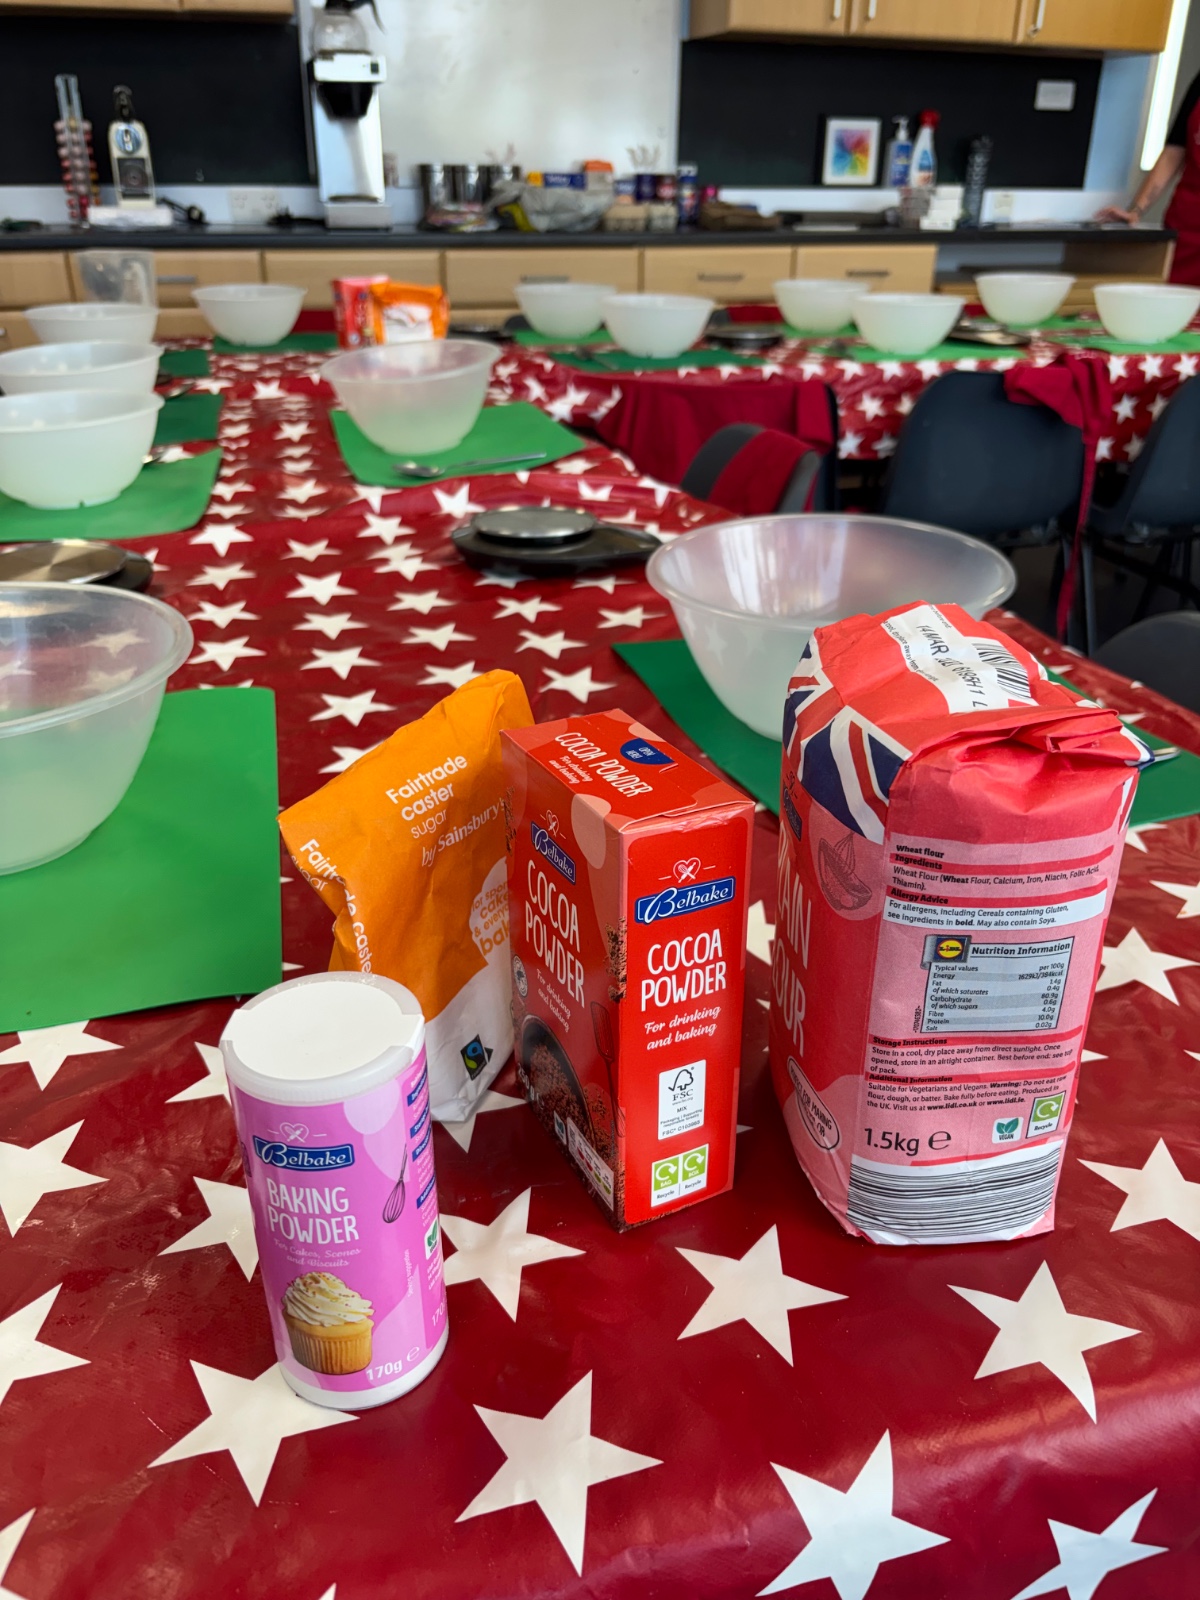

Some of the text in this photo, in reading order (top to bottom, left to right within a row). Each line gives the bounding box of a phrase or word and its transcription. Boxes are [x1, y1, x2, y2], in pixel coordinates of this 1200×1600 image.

[548, 758, 581, 785] and baking
[555, 732, 654, 798] COCOA POWDER
[568, 761, 594, 782] drinking
[385, 755, 468, 805] Fairtrade
[401, 783, 454, 821] caster
[410, 809, 447, 840] sugar
[421, 846, 437, 868] by
[534, 829, 573, 877] Belbake
[895, 854, 942, 870] Ingredients
[896, 844, 944, 858] Wheat flour
[893, 866, 917, 877] Wheat
[919, 871, 939, 881] Flour
[940, 874, 969, 884] (Wheat
[970, 877, 991, 885] Flour,
[993, 877, 1025, 885] Calcium,
[1045, 873, 1068, 882] Niacin,
[527, 859, 580, 953] COCOA
[644, 887, 729, 924] Belbake
[891, 888, 948, 904] Allergy Advice
[888, 911, 900, 919] see
[902, 913, 944, 925] ingredients
[1011, 918, 1037, 926] contain
[1039, 917, 1056, 925] Soya.
[889, 900, 1068, 918] For allergens, including Cereals containing Gluten,
[352, 921, 373, 974] caste
[525, 900, 585, 1008] POWDER
[647, 928, 723, 975] COCOA
[972, 943, 1070, 955] Nutrition Information
[641, 961, 727, 1012] POWDER
[546, 985, 571, 1019] drinking
[930, 995, 972, 1003] Carbohydrate
[549, 1003, 570, 1033] baking
[644, 1006, 721, 1035] For drinking
[647, 1023, 717, 1050] and baking
[873, 1037, 947, 1047] Storage Instructions
[871, 1057, 899, 1066] opened,
[938, 1056, 961, 1065] airtight
[872, 1047, 890, 1056] Store
[906, 1049, 922, 1057] cool,
[924, 1049, 935, 1057] dry
[868, 1082, 896, 1092] Suitable
[898, 1084, 907, 1092] for
[909, 1084, 948, 1094] Vegetarians
[964, 1083, 988, 1091] Vegans.
[869, 1074, 908, 1083] Additional
[673, 1089, 693, 1101] FSC
[867, 1091, 885, 1100] flour,
[887, 1095, 911, 1103] dough,
[977, 1090, 997, 1098] before
[1022, 1086, 1052, 1094] Produced
[811, 1101, 832, 1130] MAKING
[893, 1103, 908, 1111] Visit
[927, 1101, 977, 1111] www.lidl.co.uk
[864, 1127, 920, 1157] 1.5kg
[999, 1122, 1053, 1141] VEGAN Recycle
[261, 1142, 346, 1166] Belbake
[656, 1179, 702, 1199] Recycle Recycle
[660, 1170, 699, 1188] BAG BOX
[267, 1177, 349, 1215] BAKING
[268, 1205, 359, 1245] POWDER
[286, 1254, 349, 1267] and Biscuits
[289, 1246, 361, 1258] Cakes, Scones
[366, 1359, 403, 1381] 170g
